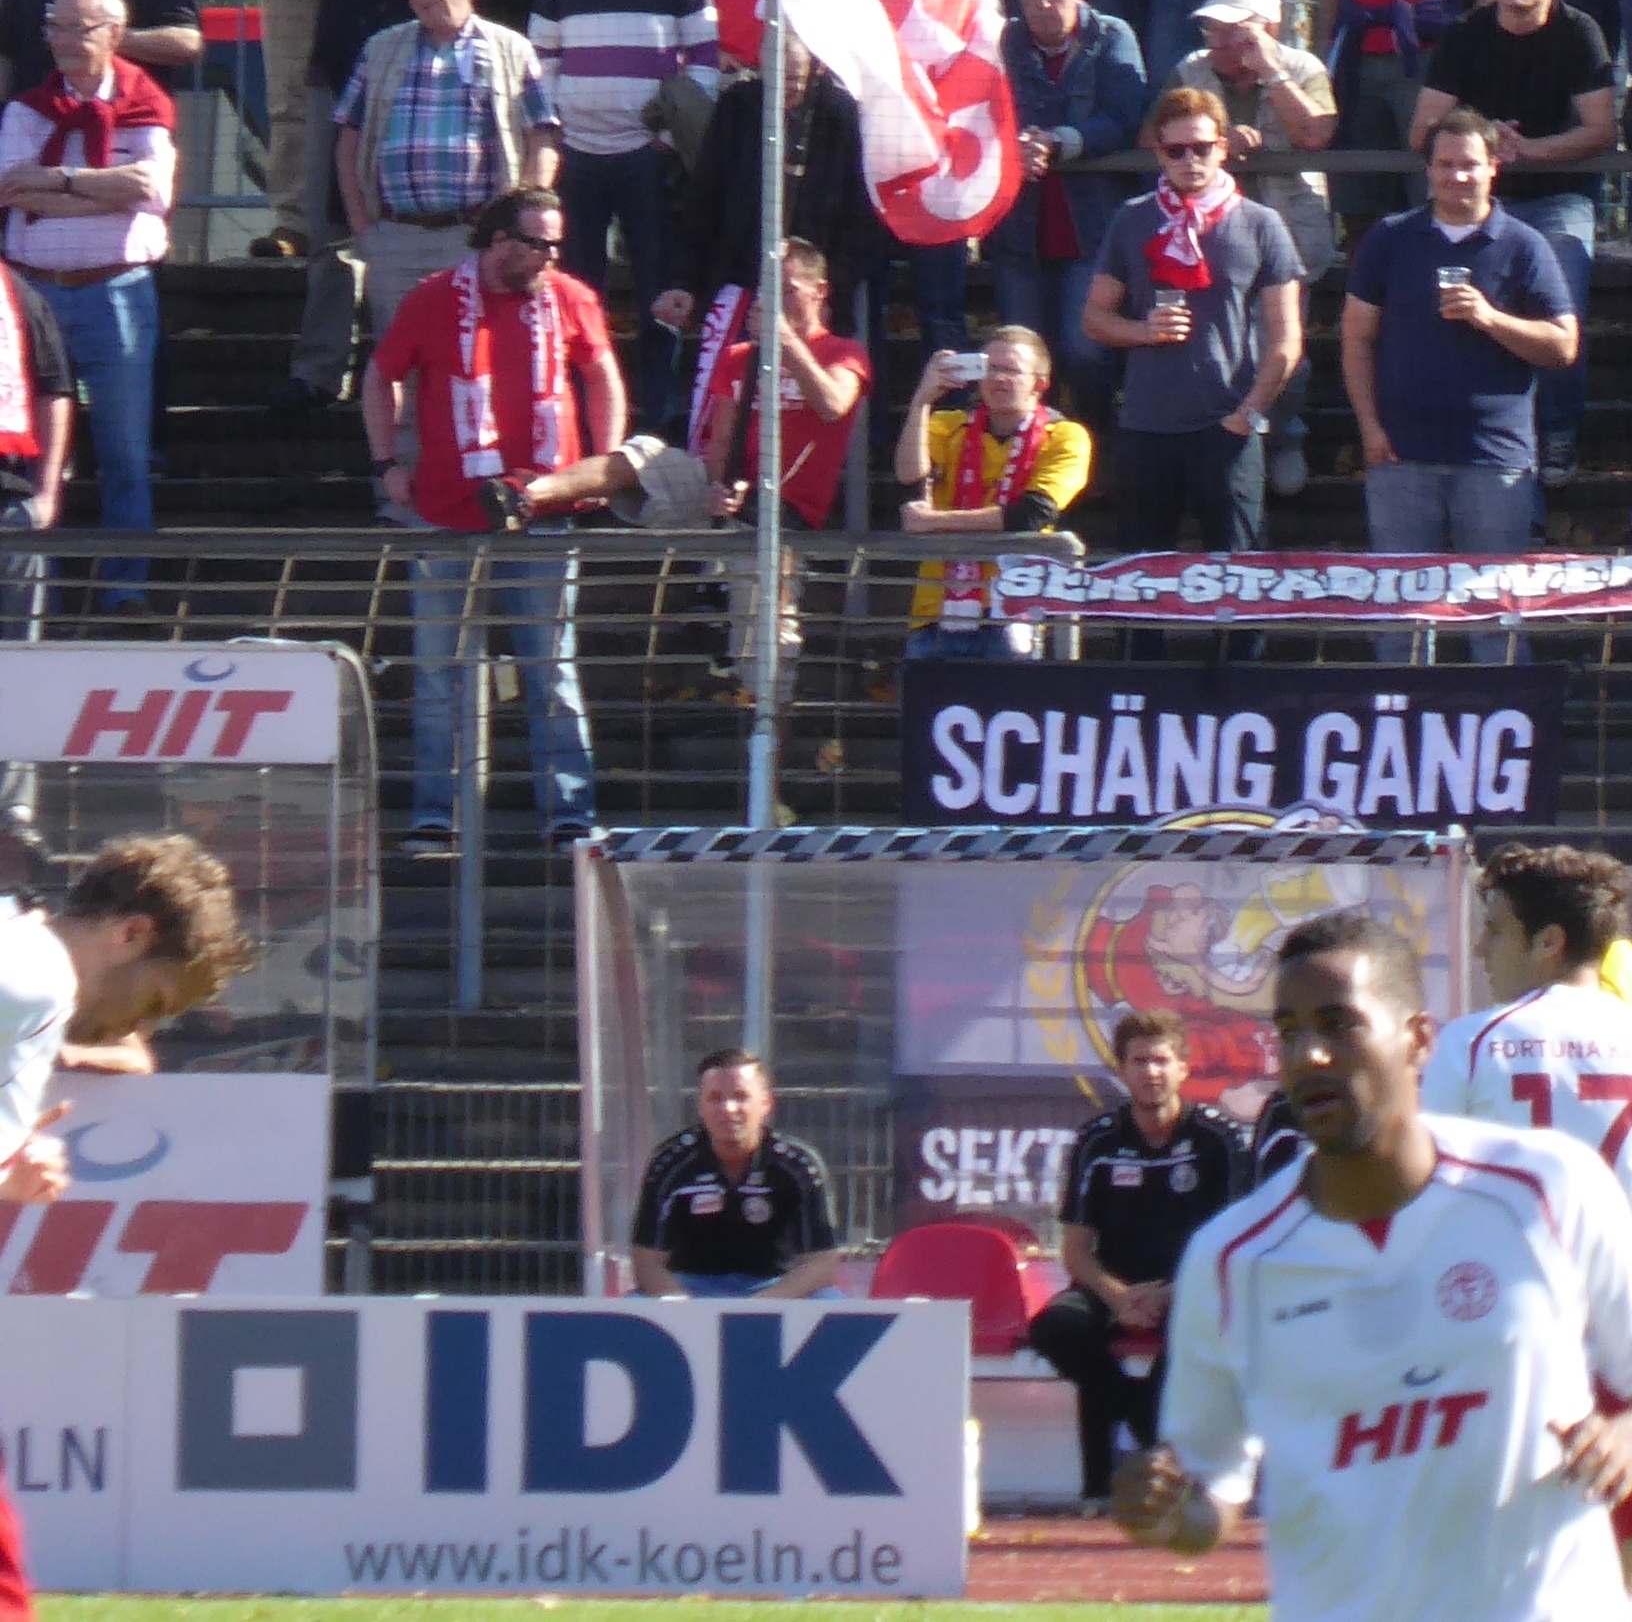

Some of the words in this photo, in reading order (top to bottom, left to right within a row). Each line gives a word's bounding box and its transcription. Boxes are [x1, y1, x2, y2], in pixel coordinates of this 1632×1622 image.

[61, 689, 294, 758] HIT
[930, 694, 1277, 818] SCHÄNG
[1302, 694, 1535, 816] GÄNG
[920, 1126, 1077, 1205] SEKT
[424, 1312, 905, 1497] IDK
[1330, 1389, 1491, 1472] HIT
[0, 1425, 107, 1490] LN
[344, 1527, 902, 1584] www.idk-koeln.de
